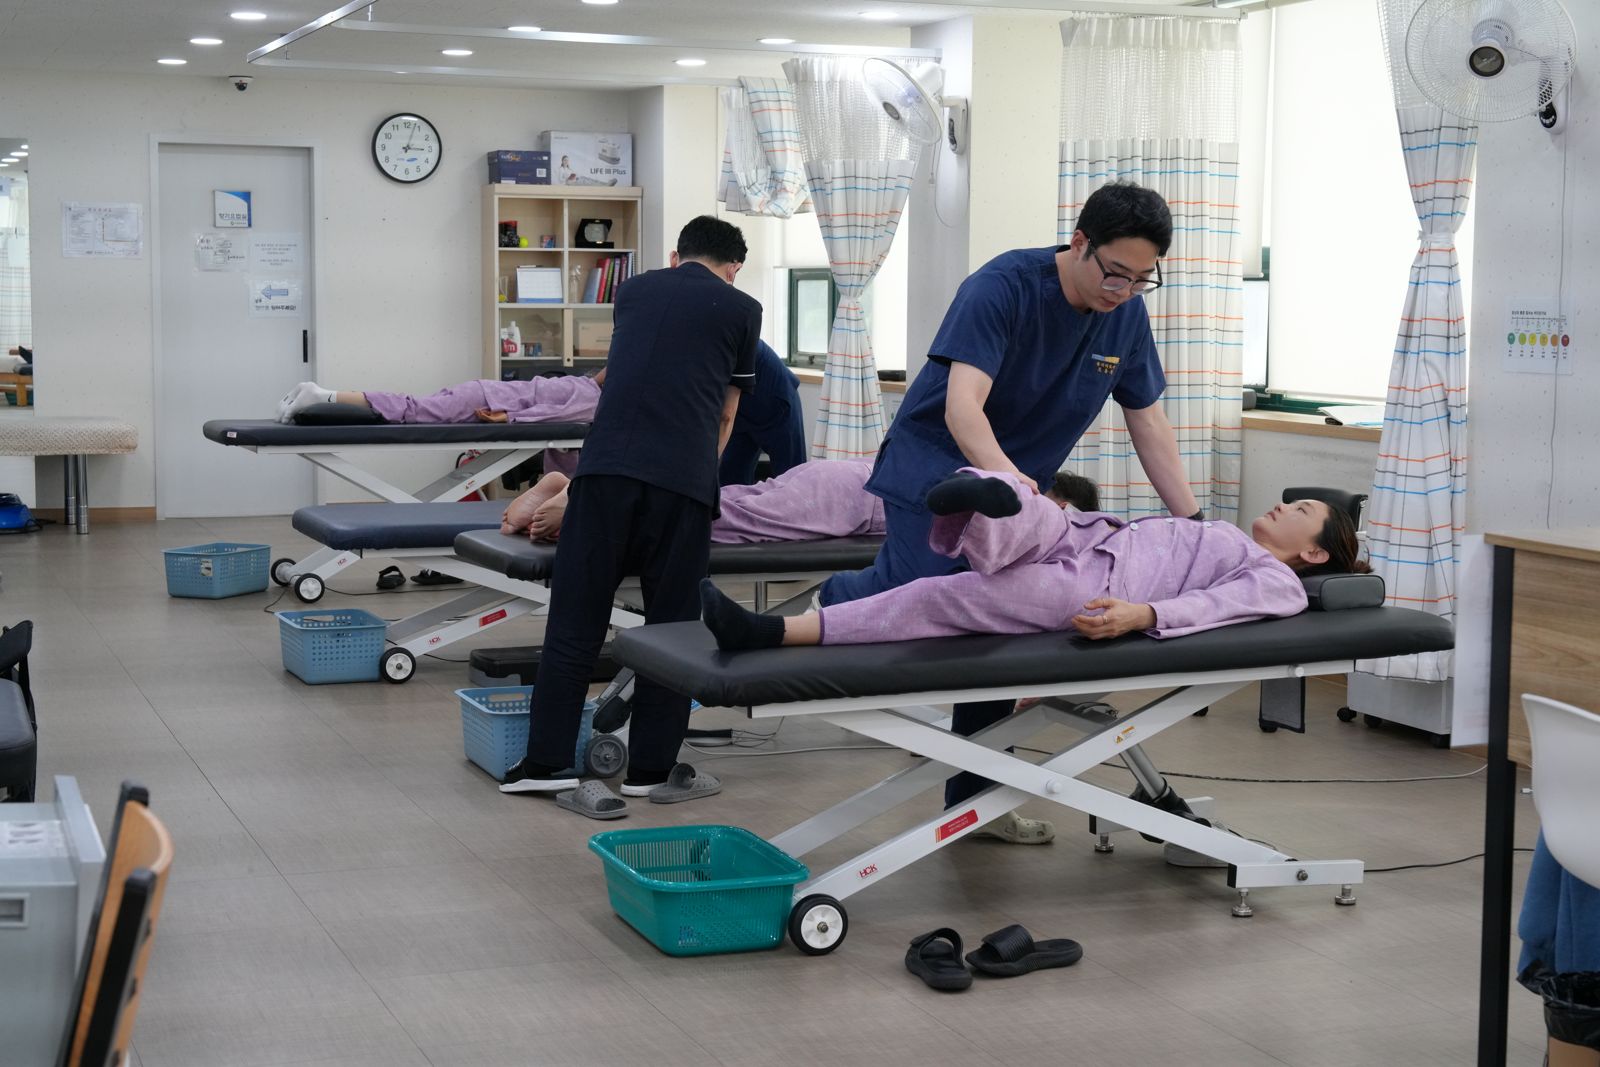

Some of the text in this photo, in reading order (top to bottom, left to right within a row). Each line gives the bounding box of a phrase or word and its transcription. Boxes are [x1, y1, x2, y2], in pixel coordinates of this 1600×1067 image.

[384, 132, 392, 140] 10
[612, 168, 627, 176] Plus
[859, 863, 877, 878] HCK
